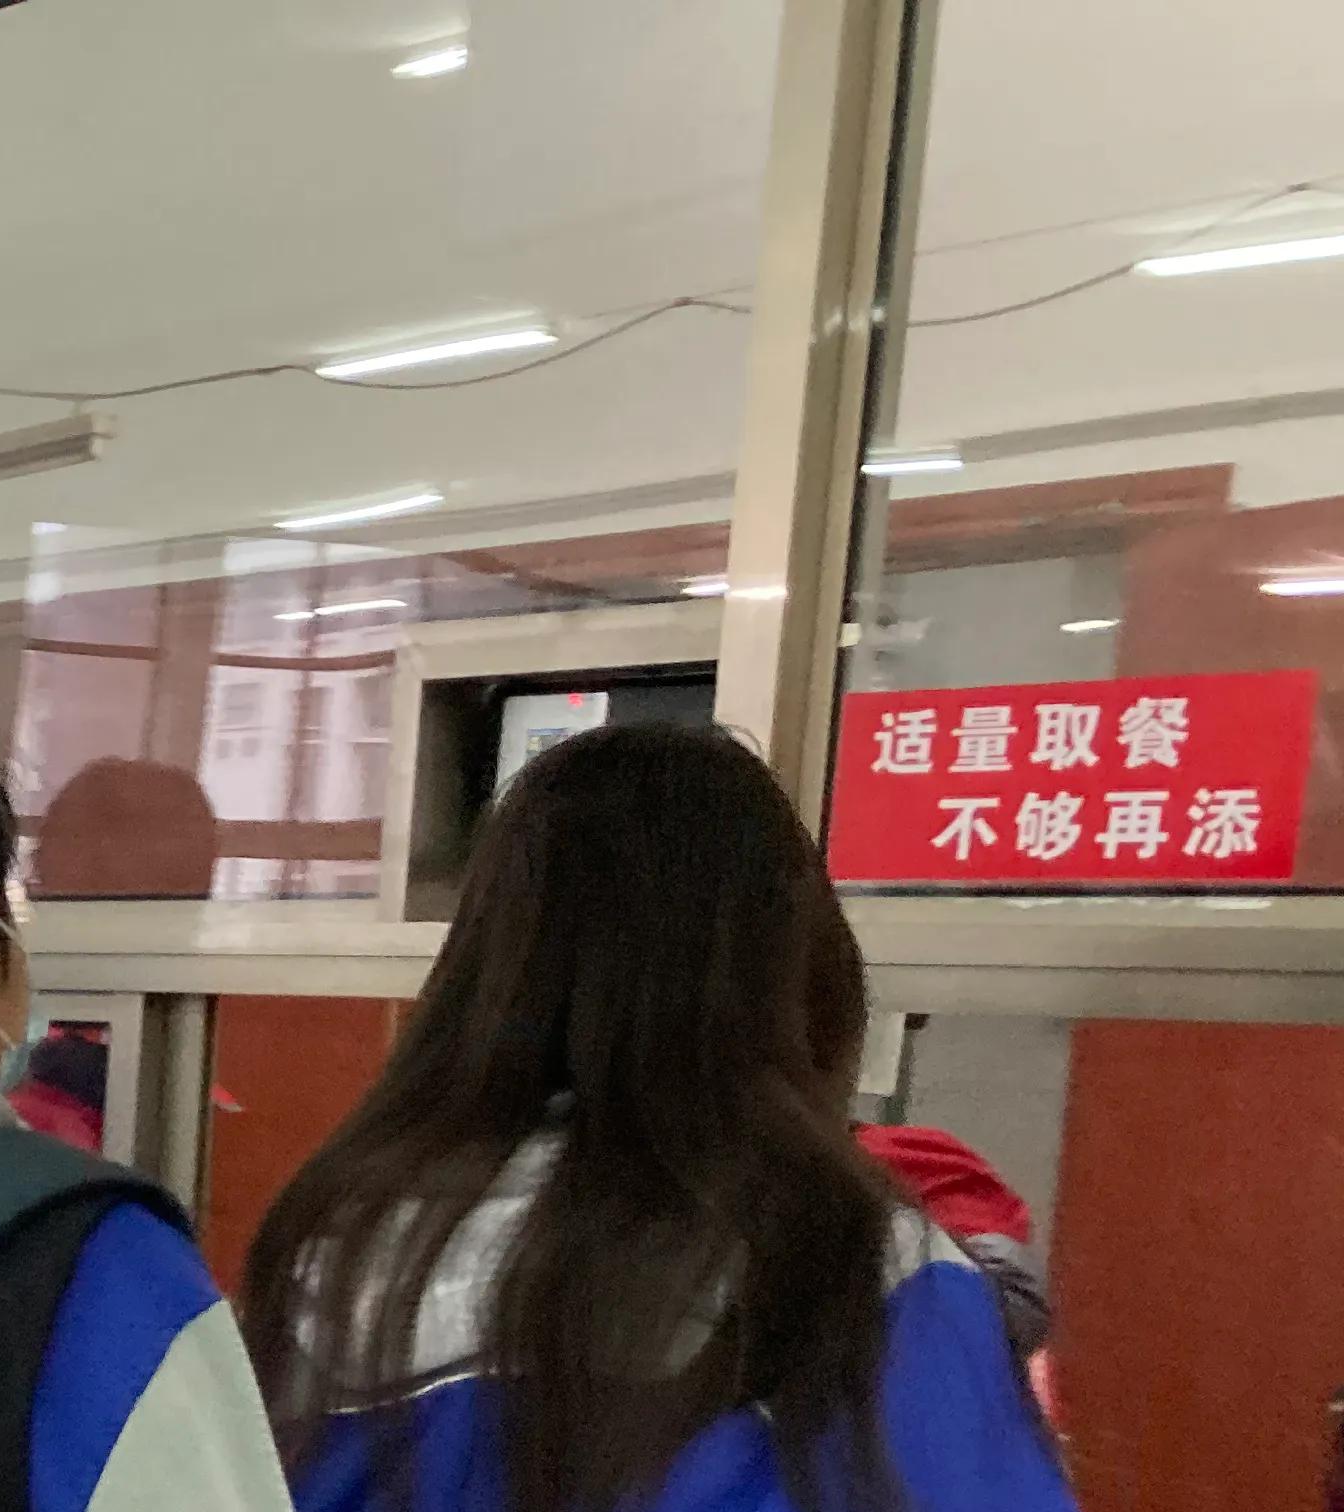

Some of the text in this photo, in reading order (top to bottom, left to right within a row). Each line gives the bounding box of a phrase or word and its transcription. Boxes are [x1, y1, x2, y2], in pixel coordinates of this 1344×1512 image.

[870, 696, 1190, 774] 适量取餐
[930, 787, 1262, 861] 不够再添
